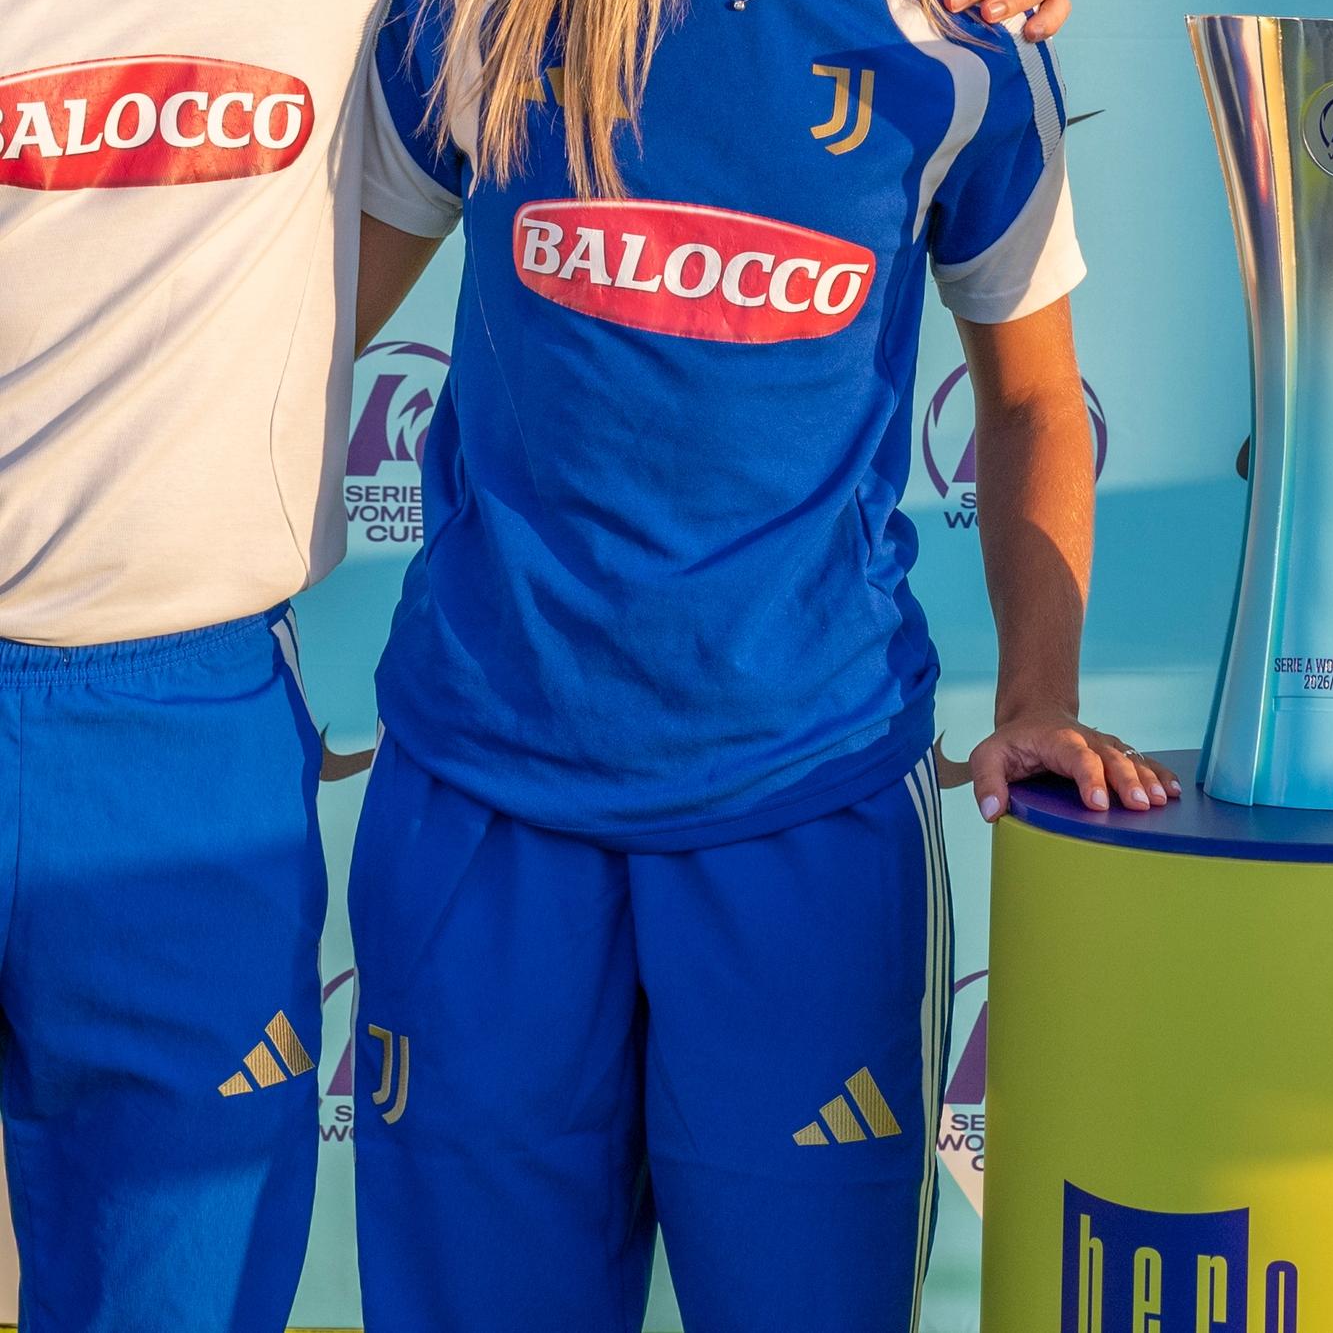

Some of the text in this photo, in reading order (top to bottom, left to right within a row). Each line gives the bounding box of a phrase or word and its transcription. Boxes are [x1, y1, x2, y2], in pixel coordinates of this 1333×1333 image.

[521, 218, 869, 315] BALOCCO
[1274, 657, 1303, 673] SERIE
[1305, 658, 1313, 673] A
